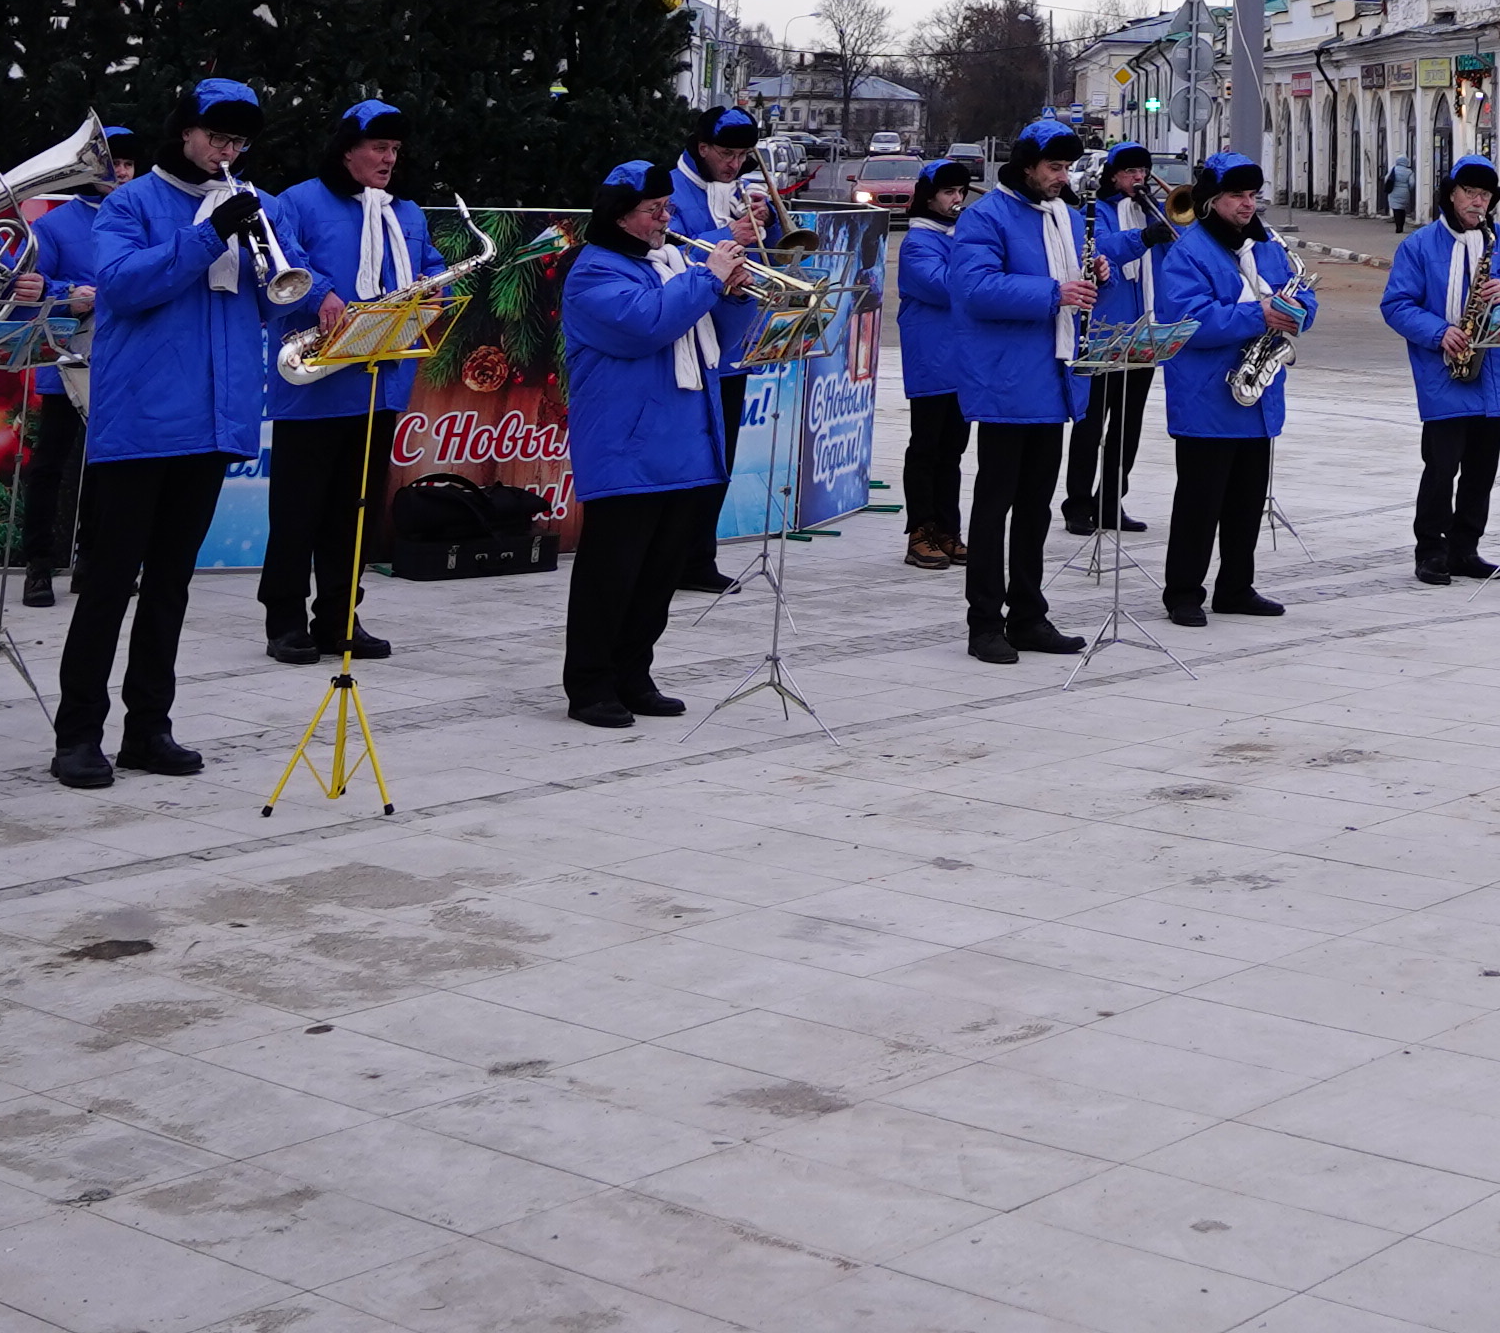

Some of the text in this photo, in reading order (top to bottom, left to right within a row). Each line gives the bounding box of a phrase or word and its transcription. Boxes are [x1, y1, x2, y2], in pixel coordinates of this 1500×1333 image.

[809, 377, 825, 431] С
[823, 371, 873, 428] Новым
[392, 413, 428, 465] С
[814, 421, 863, 490] Годом!
